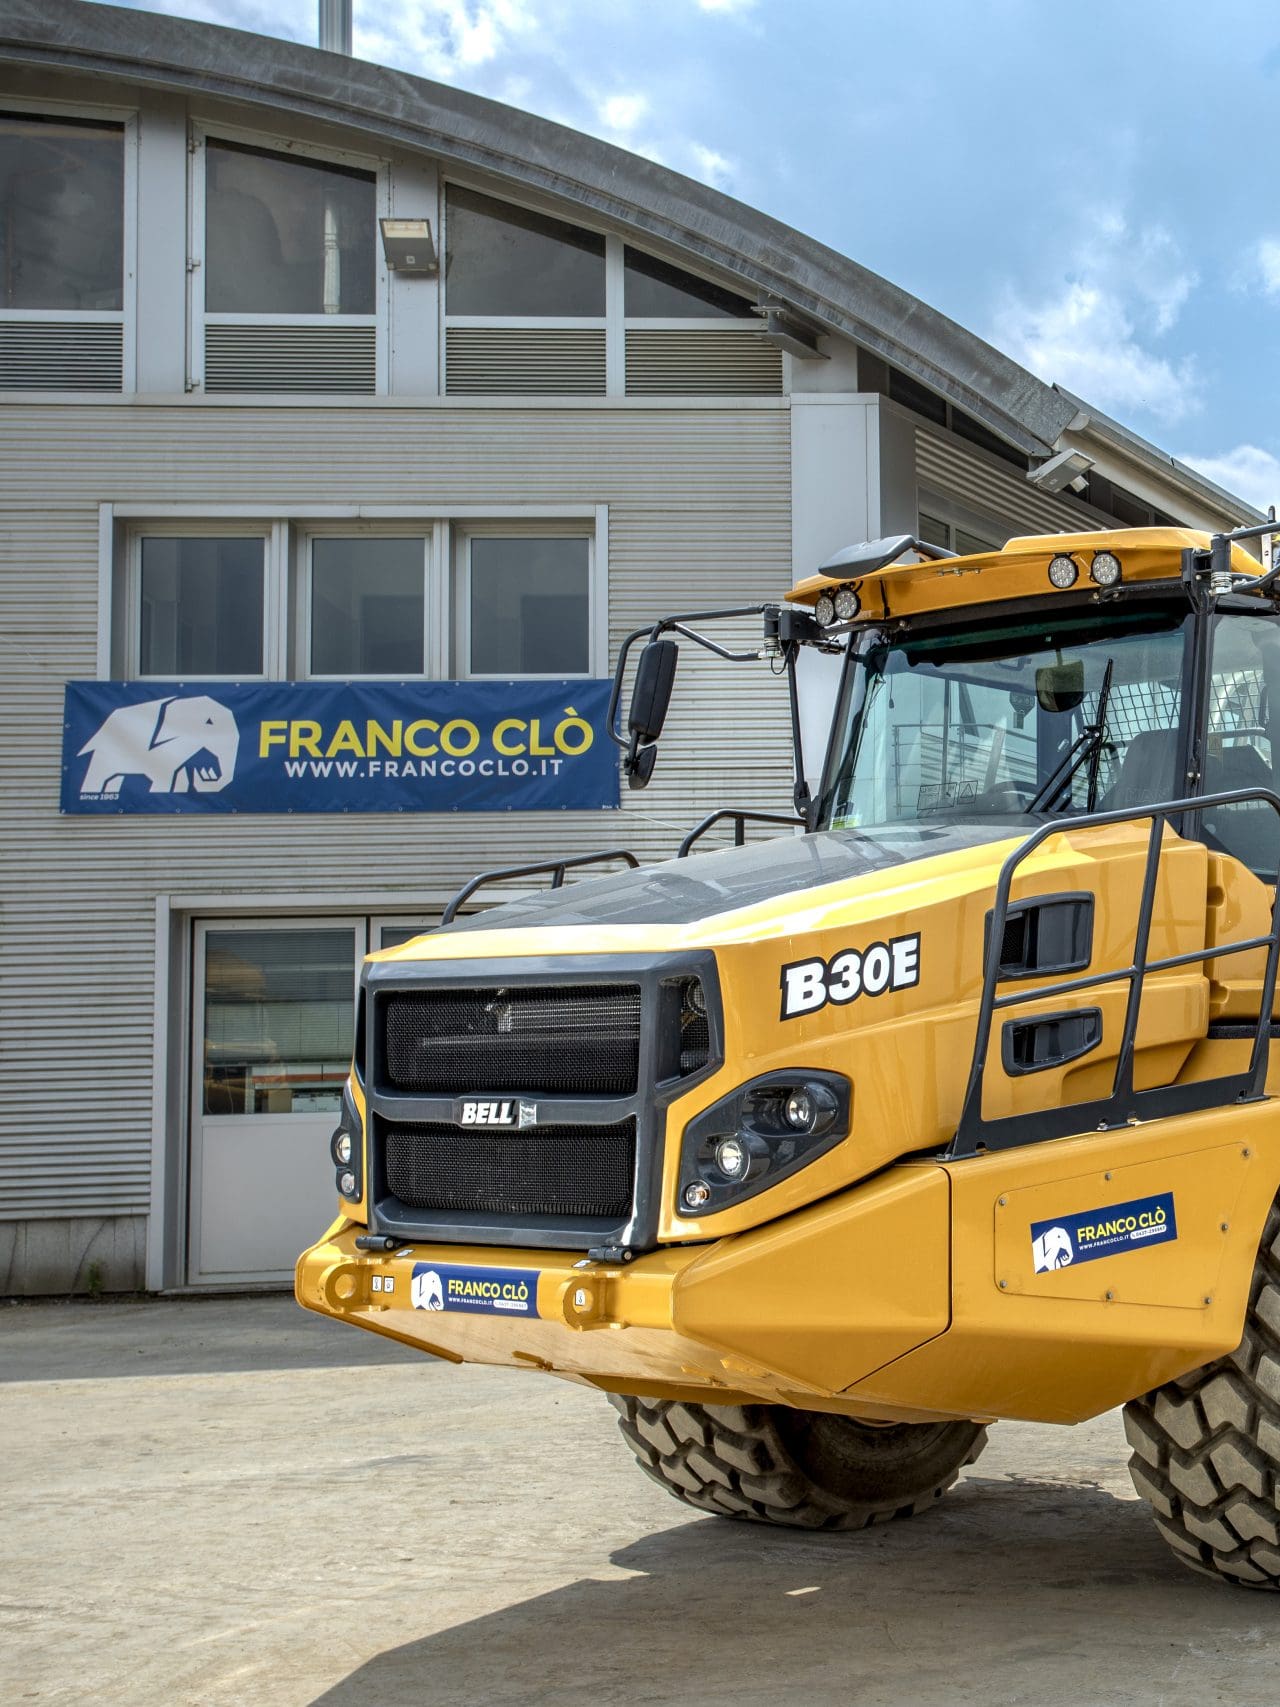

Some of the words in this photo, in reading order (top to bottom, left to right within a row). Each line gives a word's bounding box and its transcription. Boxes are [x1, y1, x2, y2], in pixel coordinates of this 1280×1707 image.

[259, 719, 480, 758] FRANCO
[492, 706, 594, 756] CLÒ
[284, 758, 563, 778] WWW.FRANCOCLO.IT
[781, 933, 920, 1020] B30E
[461, 1102, 513, 1125] BELL
[1077, 1216, 1137, 1243] FRANCO
[1138, 1205, 1166, 1228] CLÒ
[448, 1279, 501, 1299] FRANCO
[502, 1281, 529, 1301] CLÒ
